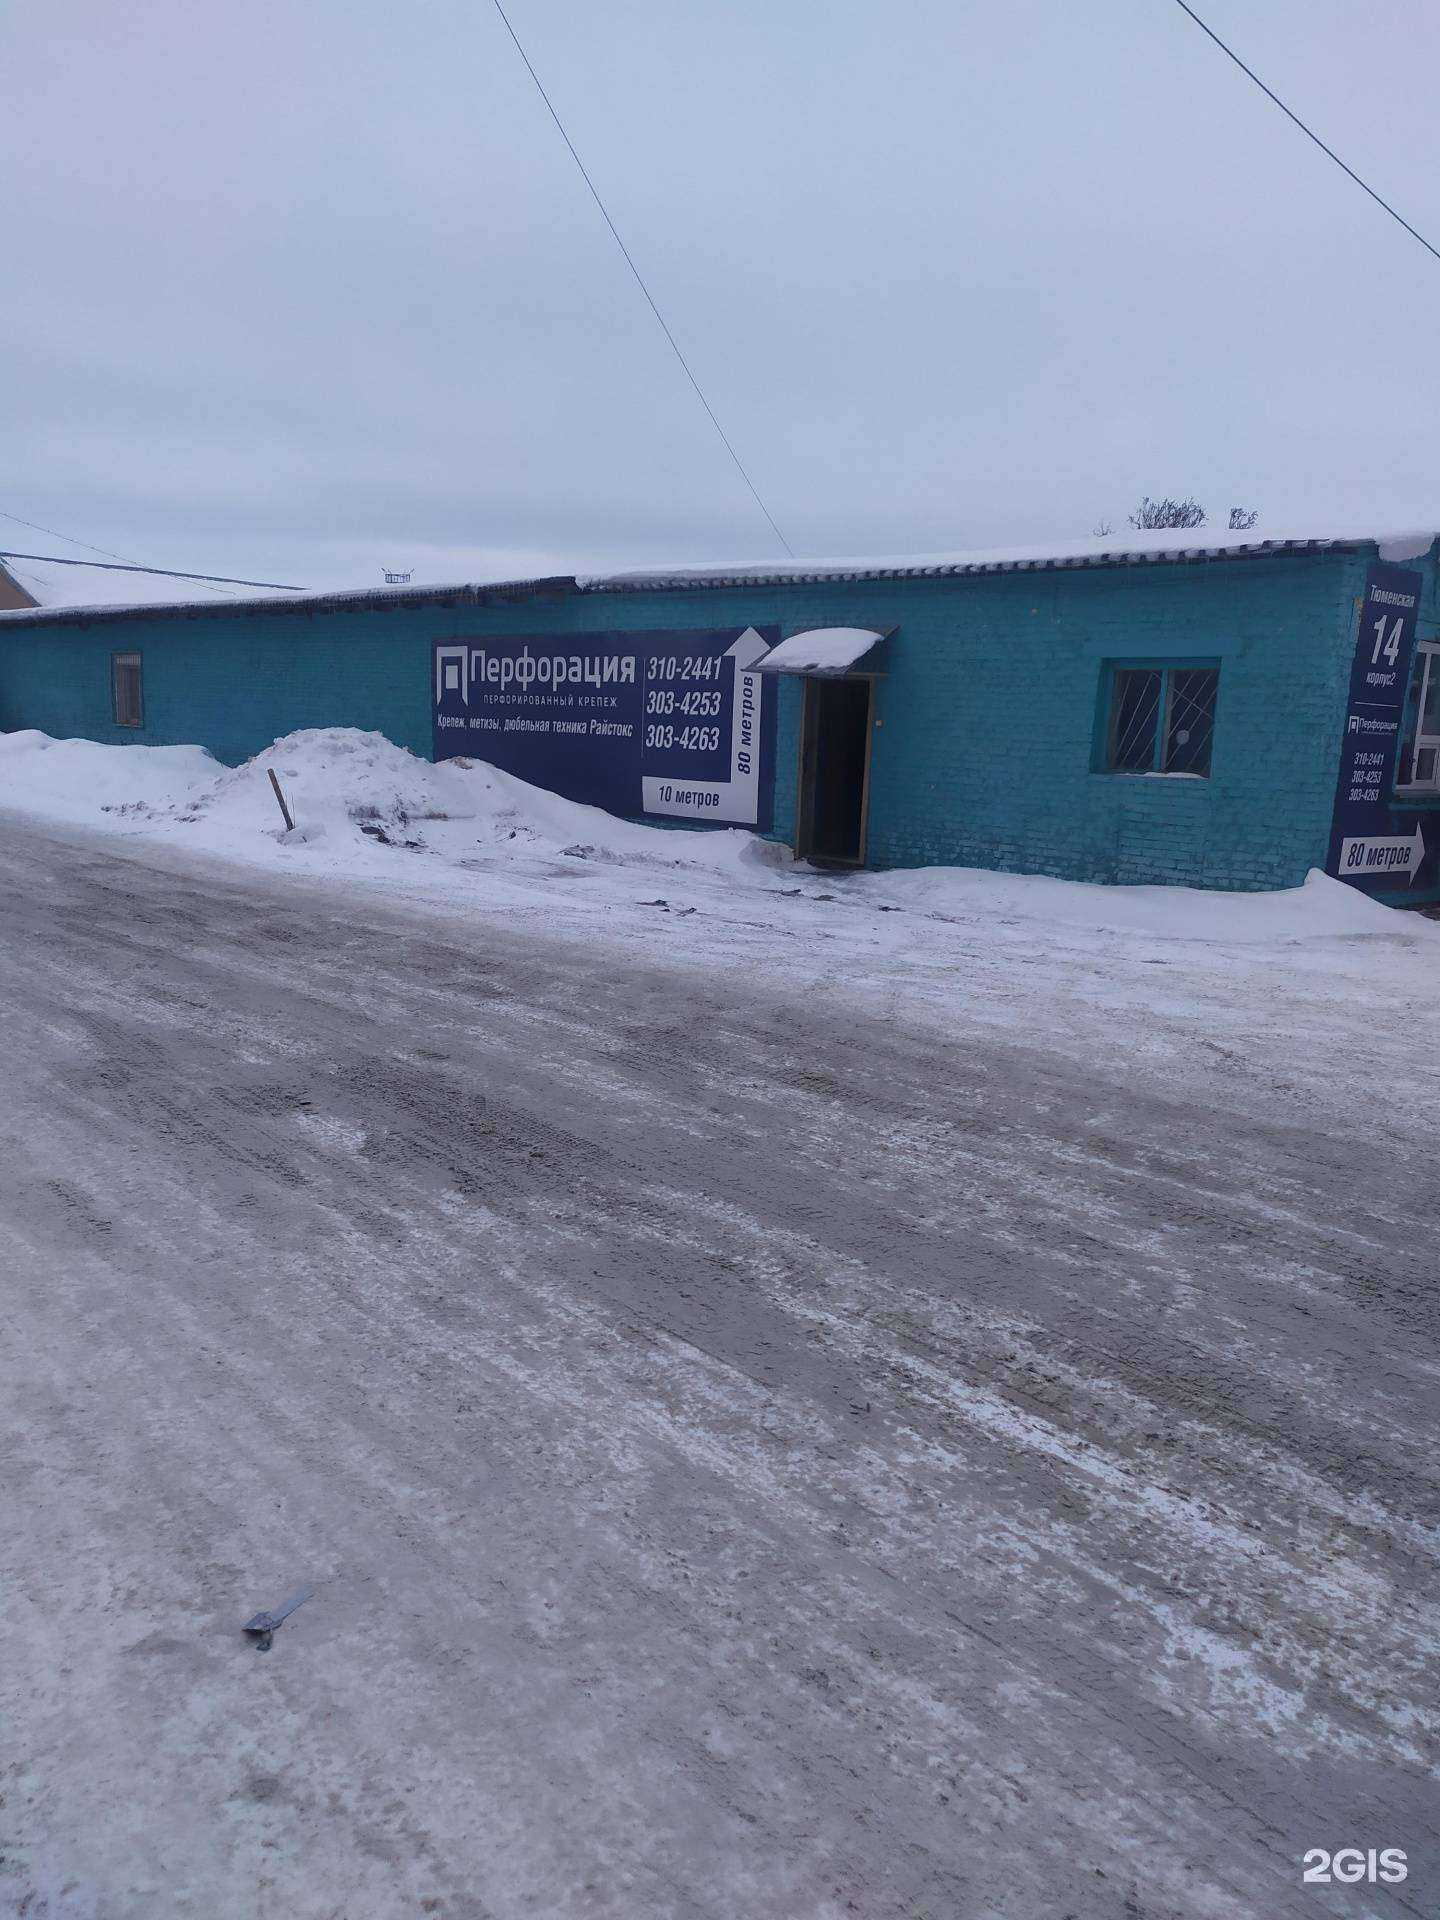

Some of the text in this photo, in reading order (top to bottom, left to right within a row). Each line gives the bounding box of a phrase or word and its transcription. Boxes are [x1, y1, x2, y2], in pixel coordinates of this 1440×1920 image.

[1370, 584, 1416, 608] Тюменская
[1371, 614, 1404, 666] 14
[471, 646, 635, 691] Перфорация
[647, 656, 722, 681] 310-2441
[484, 694, 618, 707] ПЕРФОРИРОВАННЫЙ КРЕПЕЖ
[646, 691, 722, 716] 303-4253
[437, 714, 634, 737] Крепеж, метизы, дюбельная техника Райстокс
[738, 676, 755, 775] 80 метров
[1359, 718, 1398, 732] Перфорация
[645, 724, 720, 751] 303-4263
[1353, 752, 1384, 766] 310-2441
[1351, 771, 1382, 784] 303-4253
[659, 786, 720, 808] 10 метров
[1347, 843, 1412, 869] 80 метров
